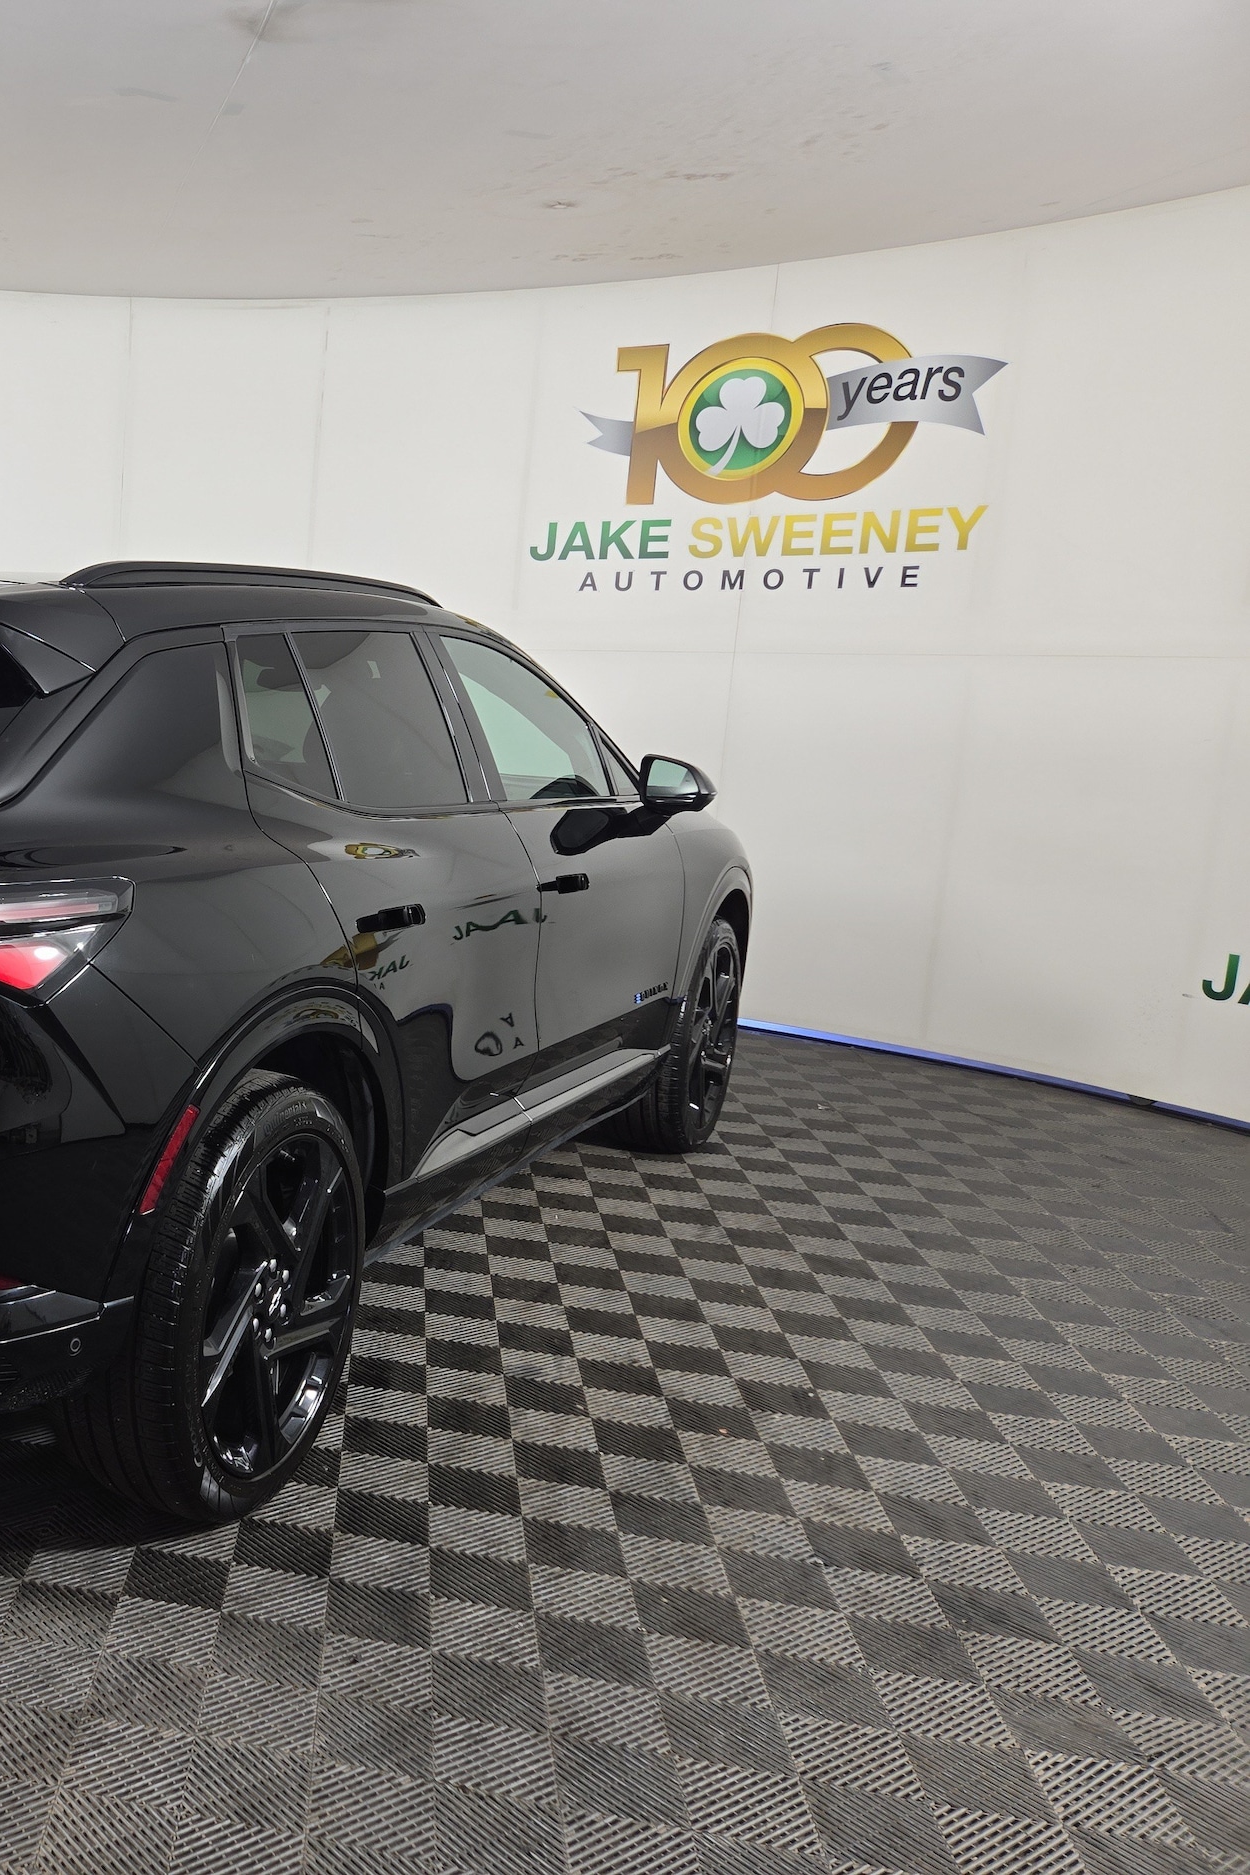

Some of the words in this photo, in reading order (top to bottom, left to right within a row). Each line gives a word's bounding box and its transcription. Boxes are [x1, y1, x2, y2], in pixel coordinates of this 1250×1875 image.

[617, 322, 919, 505] 100
[836, 360, 965, 420] years
[529, 519, 672, 561] JAKE
[688, 505, 989, 558] SWEENEY
[578, 565, 920, 591] AUTOMOTIVE
